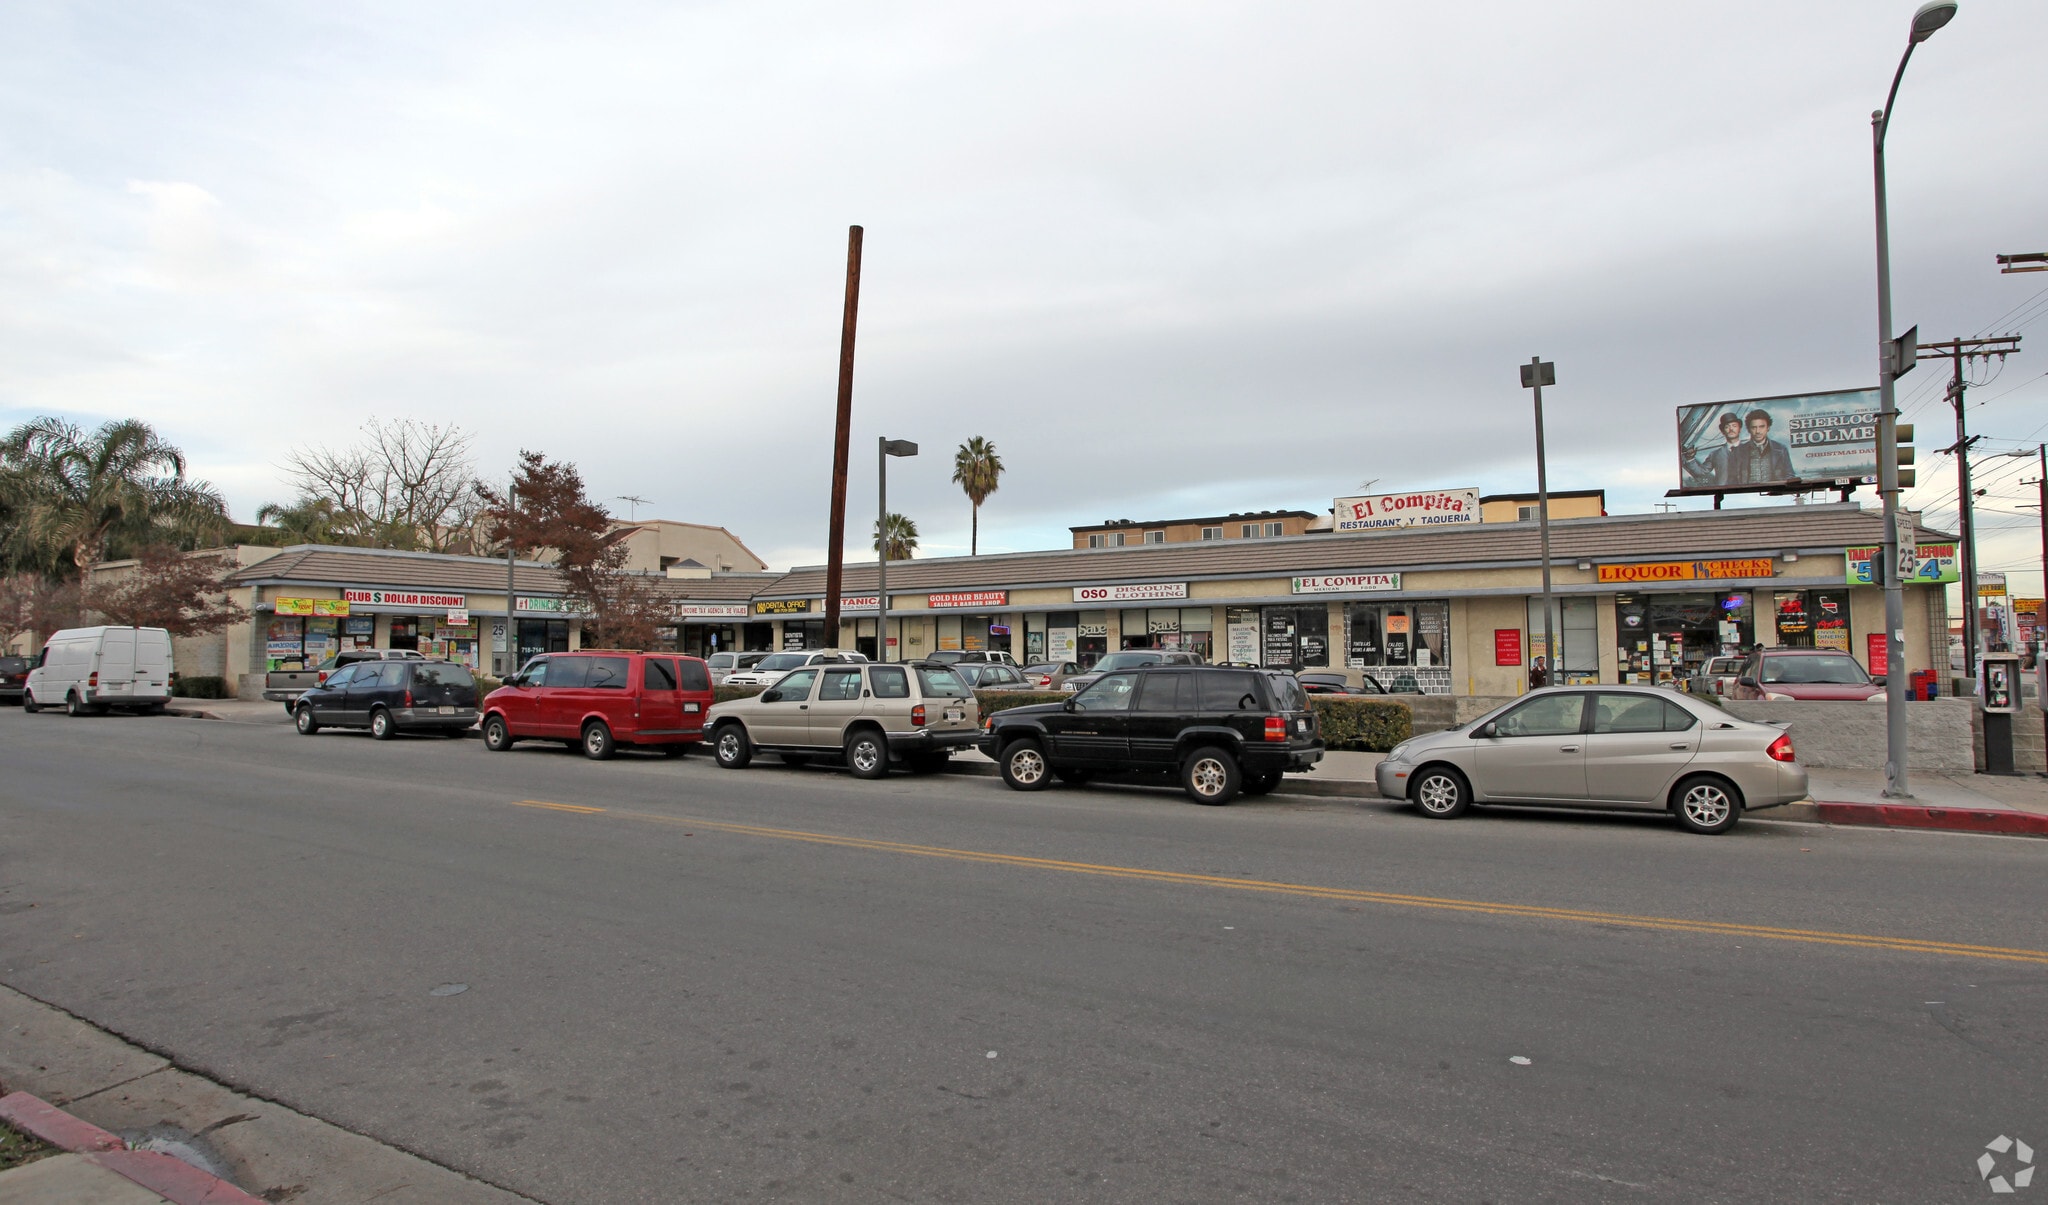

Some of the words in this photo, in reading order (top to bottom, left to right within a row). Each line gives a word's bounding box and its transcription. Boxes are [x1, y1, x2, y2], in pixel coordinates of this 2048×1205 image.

[1790, 426, 1876, 446] HOLME
[1805, 450, 1857, 458] CHRISTMAS
[1351, 500, 1374, 520] El
[1379, 493, 1463, 513] Compita
[1340, 518, 1401, 529] RESTAURANT
[1409, 517, 1415, 525] Y
[1421, 514, 1471, 524] TAQUERIA
[1897, 518, 1911, 530] SPEED
[1900, 534, 1912, 544] LIMIT
[1914, 545, 1954, 559] ELEFONO
[1710, 559, 1770, 570] CHECKS
[1899, 548, 1914, 573] 25
[1600, 565, 1682, 581] LIQUOR
[1691, 561, 1710, 579] 1%
[1710, 568, 1771, 579] CASHED
[1302, 578, 1320, 588] EL
[1324, 575, 1390, 586] COMPITA
[1081, 589, 1107, 599] OSO
[1115, 584, 1183, 593] DISCOUNT
[345, 591, 371, 602] CLUB
[384, 593, 418, 604] DOLLAR
[420, 595, 464, 606] DISCOUNT
[929, 594, 951, 602] GOLD
[952, 593, 972, 601] HAIR
[973, 592, 1006, 600] BEAUTY
[1114, 591, 1184, 599] CLOTHING
[518, 598, 528, 610] #1
[765, 601, 786, 609] DENTAL
[787, 600, 806, 608] OFFICE
